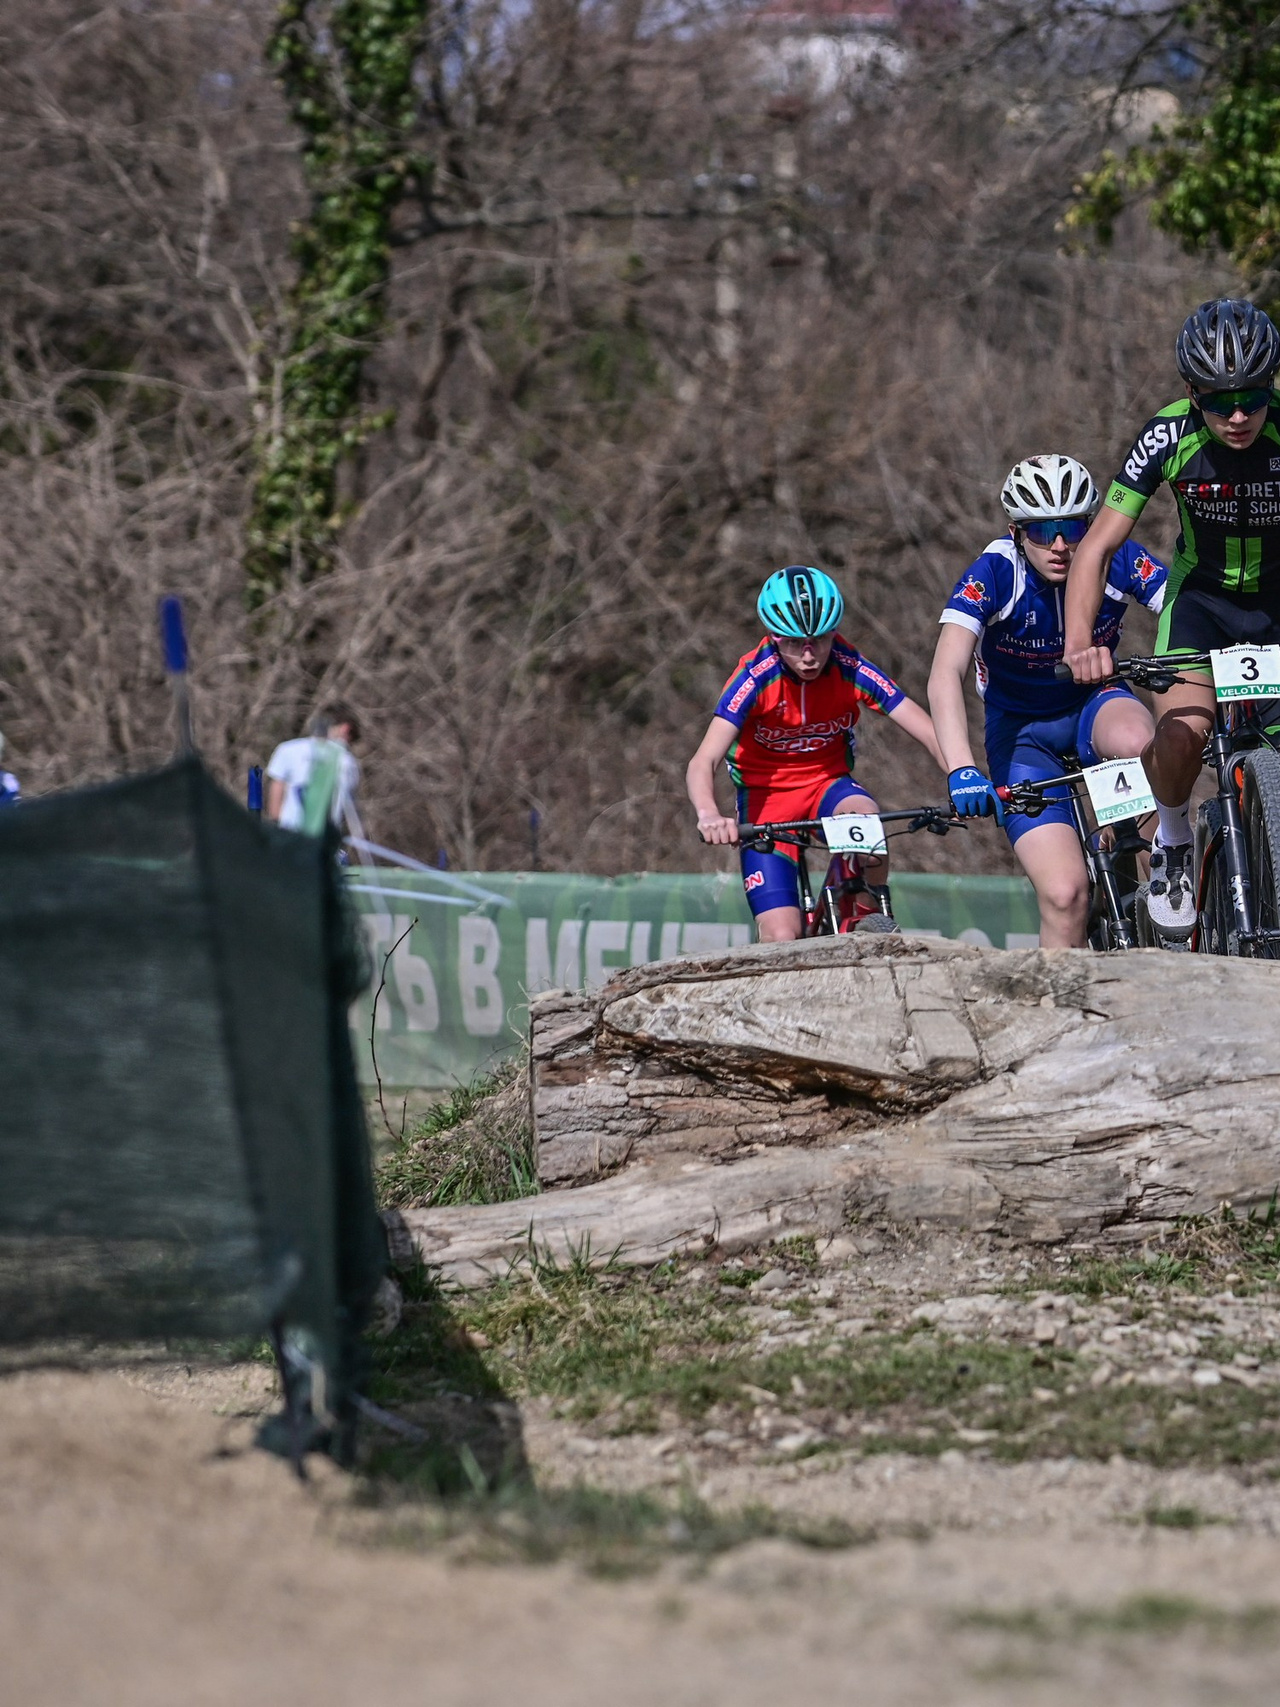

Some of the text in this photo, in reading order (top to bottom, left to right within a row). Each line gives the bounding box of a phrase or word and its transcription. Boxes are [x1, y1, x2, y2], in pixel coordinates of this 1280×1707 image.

[1240, 657, 1260, 681] 3
[1114, 771, 1132, 796] 4
[849, 826, 864, 842] 6
[459, 916, 502, 1035] В
